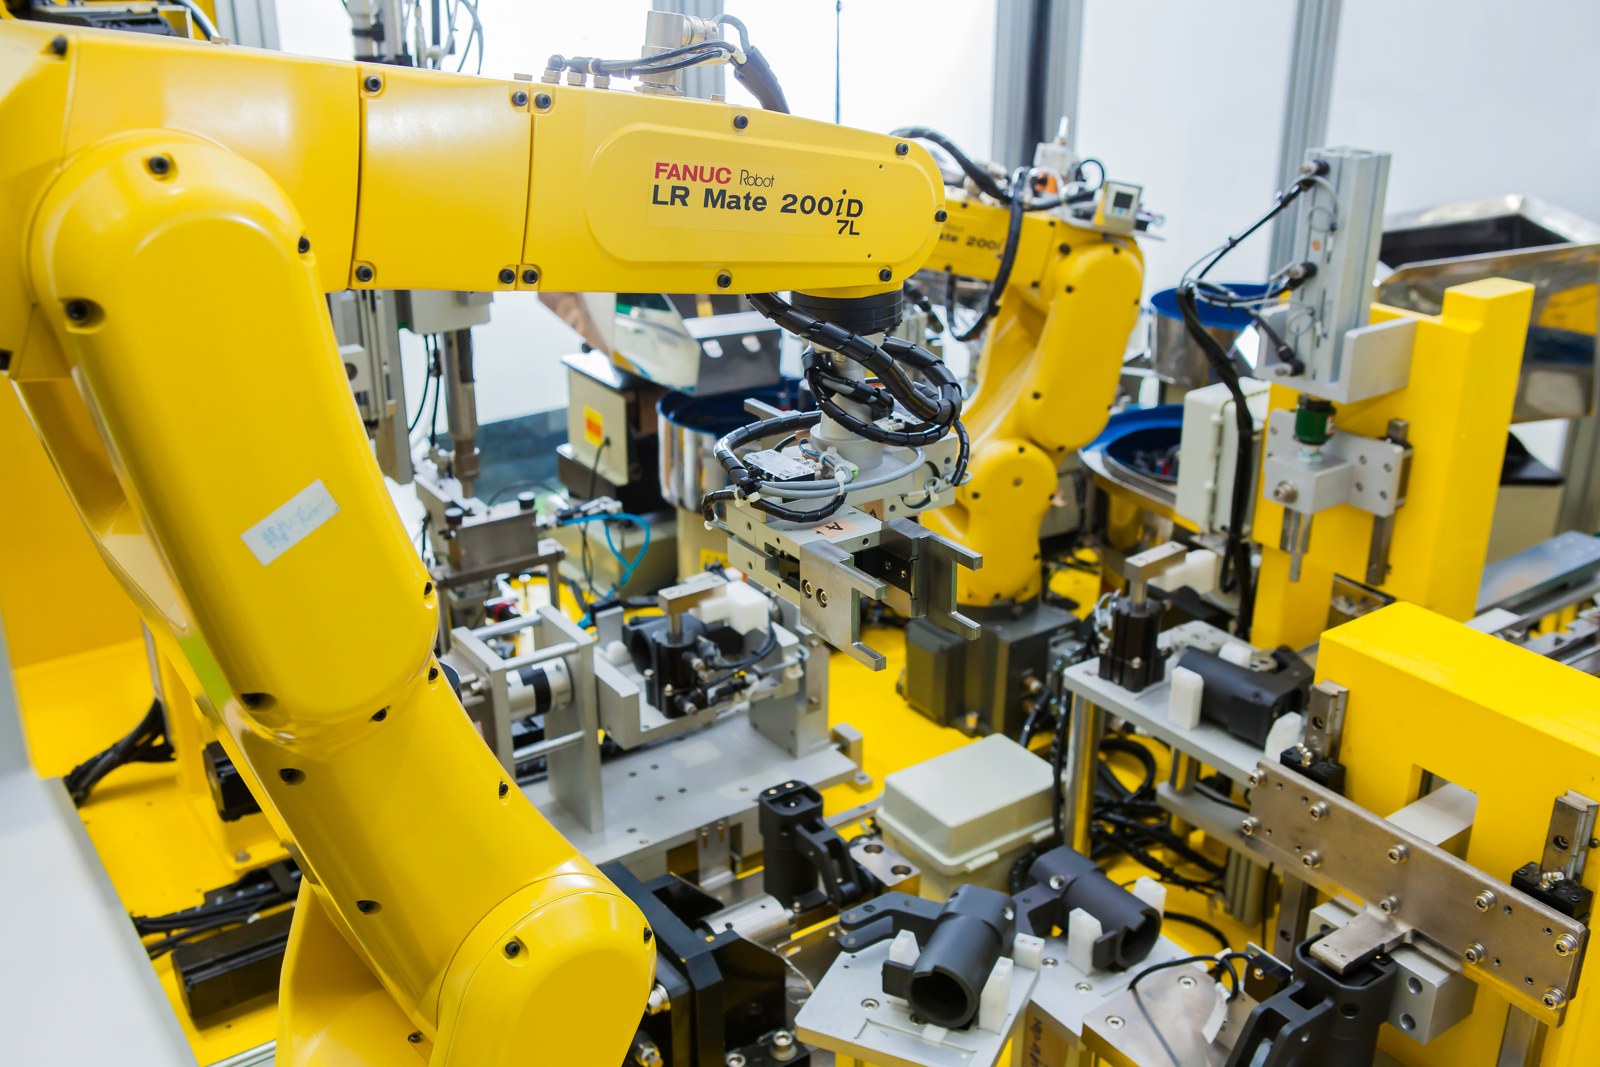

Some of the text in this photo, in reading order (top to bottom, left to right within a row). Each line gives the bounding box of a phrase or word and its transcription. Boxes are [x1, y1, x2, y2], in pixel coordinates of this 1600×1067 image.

[654, 162, 775, 188] FANUC Robot
[652, 184, 864, 218] LR Mate 200iD
[836, 219, 860, 235] 7L
